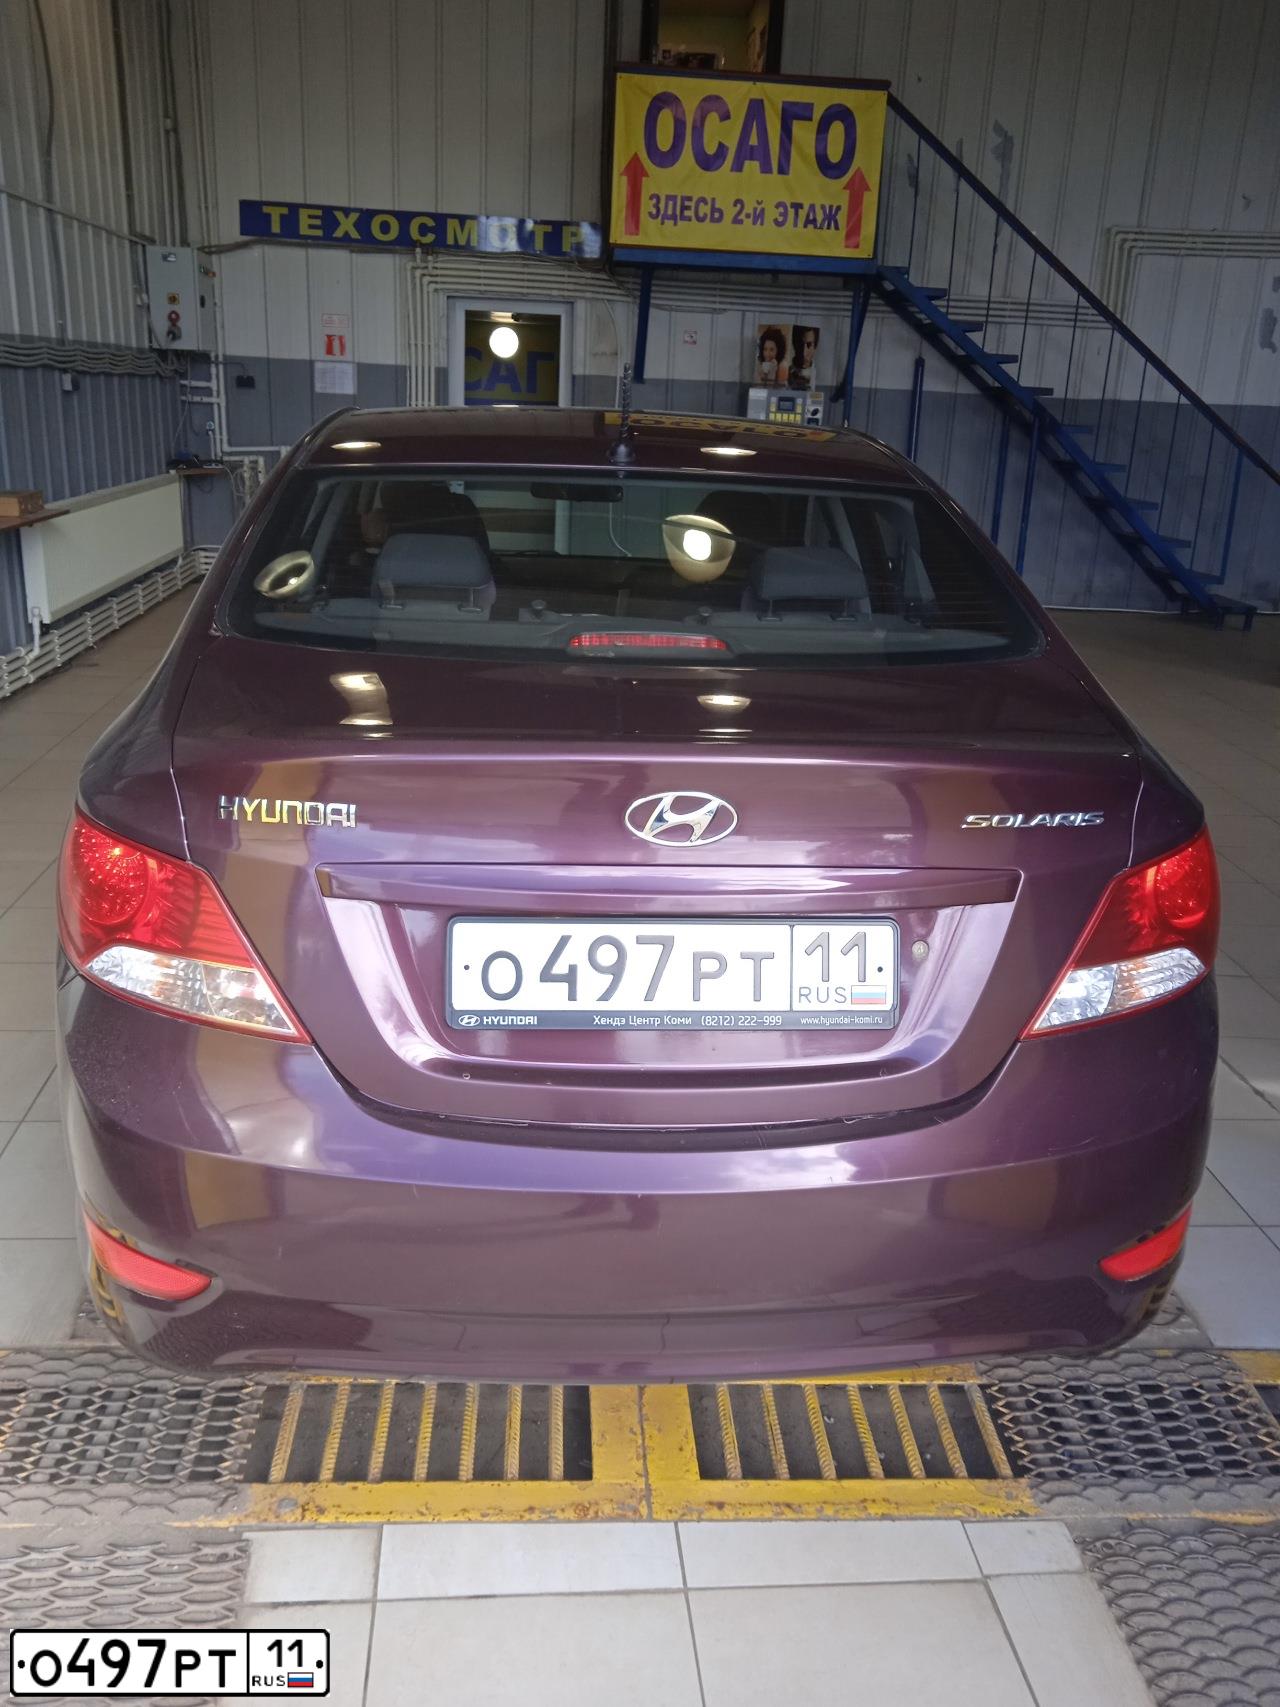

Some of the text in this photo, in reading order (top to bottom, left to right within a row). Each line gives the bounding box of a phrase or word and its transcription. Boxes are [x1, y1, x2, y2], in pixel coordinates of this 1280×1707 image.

[644, 91, 857, 180] ОСАГО
[648, 193, 842, 231] ЗДЕСЬ 2-й ЭТАЖ
[262, 205, 585, 252] ТЕХОСМОТР
[219, 795, 357, 828] HYUNDAI
[961, 811, 1105, 829] SOLARIS
[804, 931, 867, 982] 11
[798, 986, 847, 1004] RUS
[483, 1015, 538, 1025] HYUNDAI
[593, 1015, 783, 1027] Хендэ Центр Коми (8212) 222-999
[800, 1014, 883, 1025] www.hyundai-komi.ru
